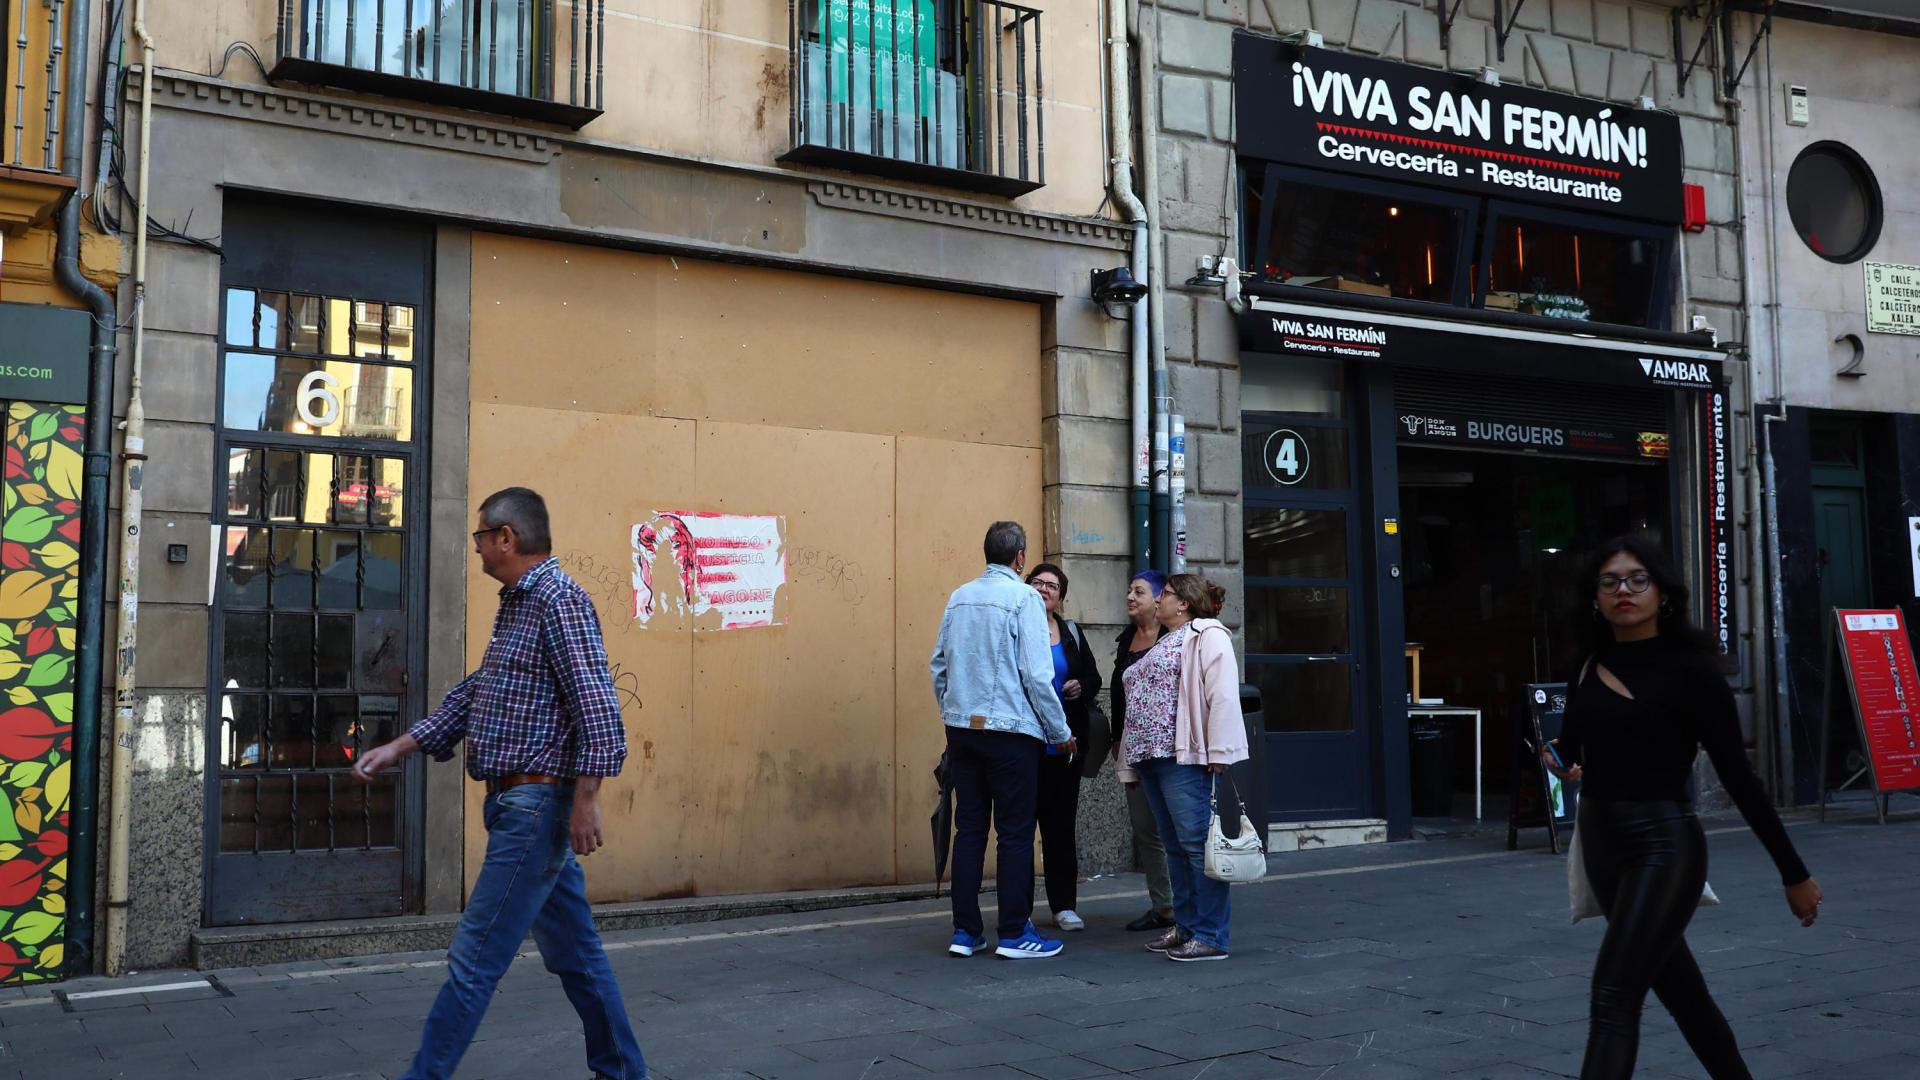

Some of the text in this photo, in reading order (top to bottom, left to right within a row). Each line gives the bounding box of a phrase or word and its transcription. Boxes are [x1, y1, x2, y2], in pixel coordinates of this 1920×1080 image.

[1292, 62, 1648, 168] ¡VIVA SAN FERMÍN!
[1317, 135, 1458, 178] Cervecería
[1482, 161, 1622, 203] Restaurante
[1891, 274, 1911, 285] CALLE
[1272, 318, 1387, 345] ¡VIVA SAN FERMÍN!
[1891, 313, 1914, 324] KALEA
[1283, 340, 1327, 352] Cervecería
[1333, 346, 1381, 358] Restaurante
[1834, 333, 1867, 379] 2
[1653, 360, 1712, 383] AMBAR
[296, 370, 340, 427] 6
[1467, 420, 1564, 447] BURGUERS
[1276, 438, 1299, 476] 4
[1713, 393, 1726, 521] Restaurante
[694, 536, 717, 549] NO
